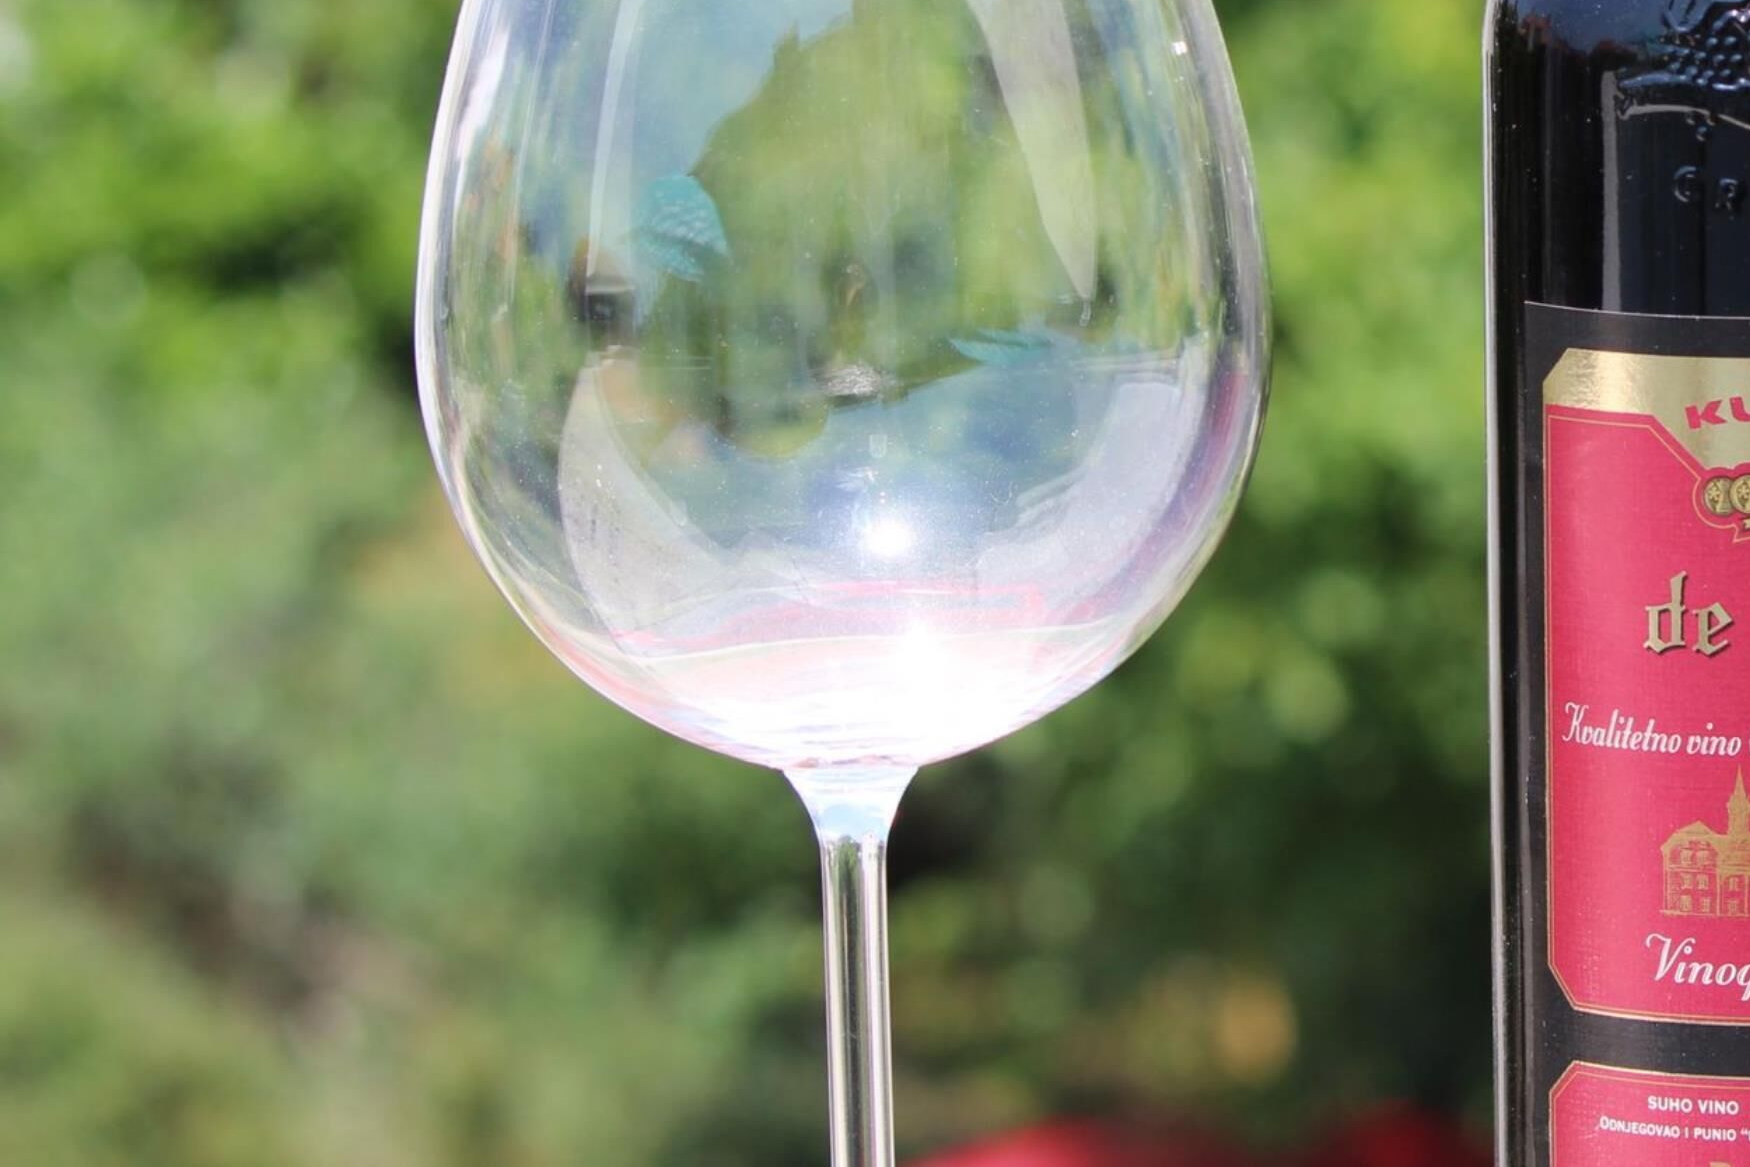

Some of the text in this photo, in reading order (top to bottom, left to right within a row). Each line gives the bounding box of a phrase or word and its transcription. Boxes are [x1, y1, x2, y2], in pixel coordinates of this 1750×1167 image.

[1643, 570, 1734, 657] de
[1562, 701, 1682, 754] Kvalitetno
[1686, 722, 1742, 756] vino
[1647, 1096, 1693, 1113] SUHO
[1697, 1099, 1739, 1115] VINO
[1599, 1115, 1680, 1139] ODNJEGOVAO
[1693, 1127, 1737, 1141] PUNIO
